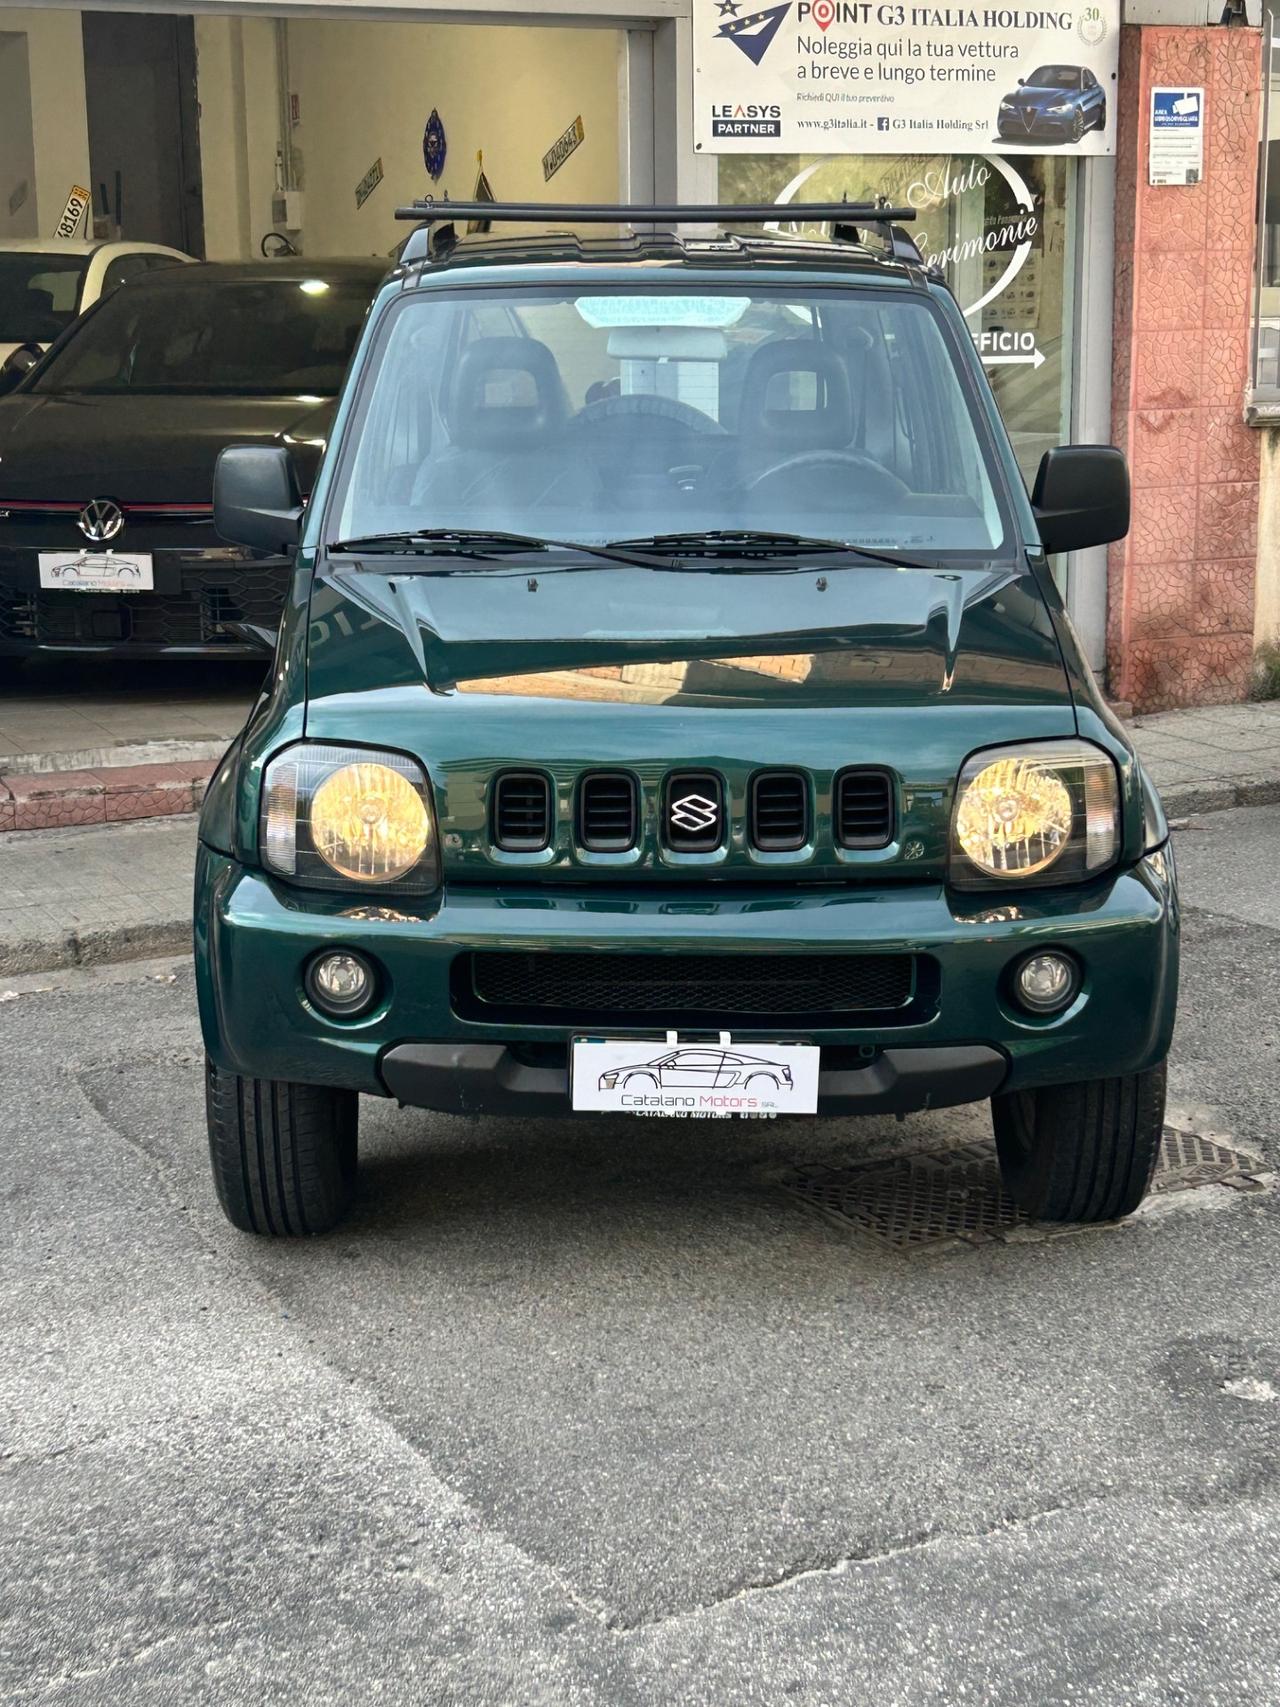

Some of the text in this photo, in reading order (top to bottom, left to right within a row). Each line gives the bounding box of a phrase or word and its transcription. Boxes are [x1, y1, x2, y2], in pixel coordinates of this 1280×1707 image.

[797, 0, 1073, 31] POINT G3 ITALIA HOLDING
[1084, 7, 1100, 22] 30
[797, 35, 1019, 60] Noleggia qui la tua vettura
[796, 60, 997, 84] a breve e lungo termine
[796, 92, 825, 103] Richiedi
[825, 92, 840, 103] QUI
[858, 94, 896, 104] preventivo
[711, 104, 781, 119] LEASYS
[717, 123, 776, 134] PARTNER
[892, 119, 907, 130] G3
[909, 119, 934, 129] Italia
[936, 119, 973, 131] Holding
[975, 119, 990, 130] Srl
[906, 153, 992, 209] Auto
[621, 1094, 696, 1107] Catalano
[699, 1095, 758, 1108] Motors
